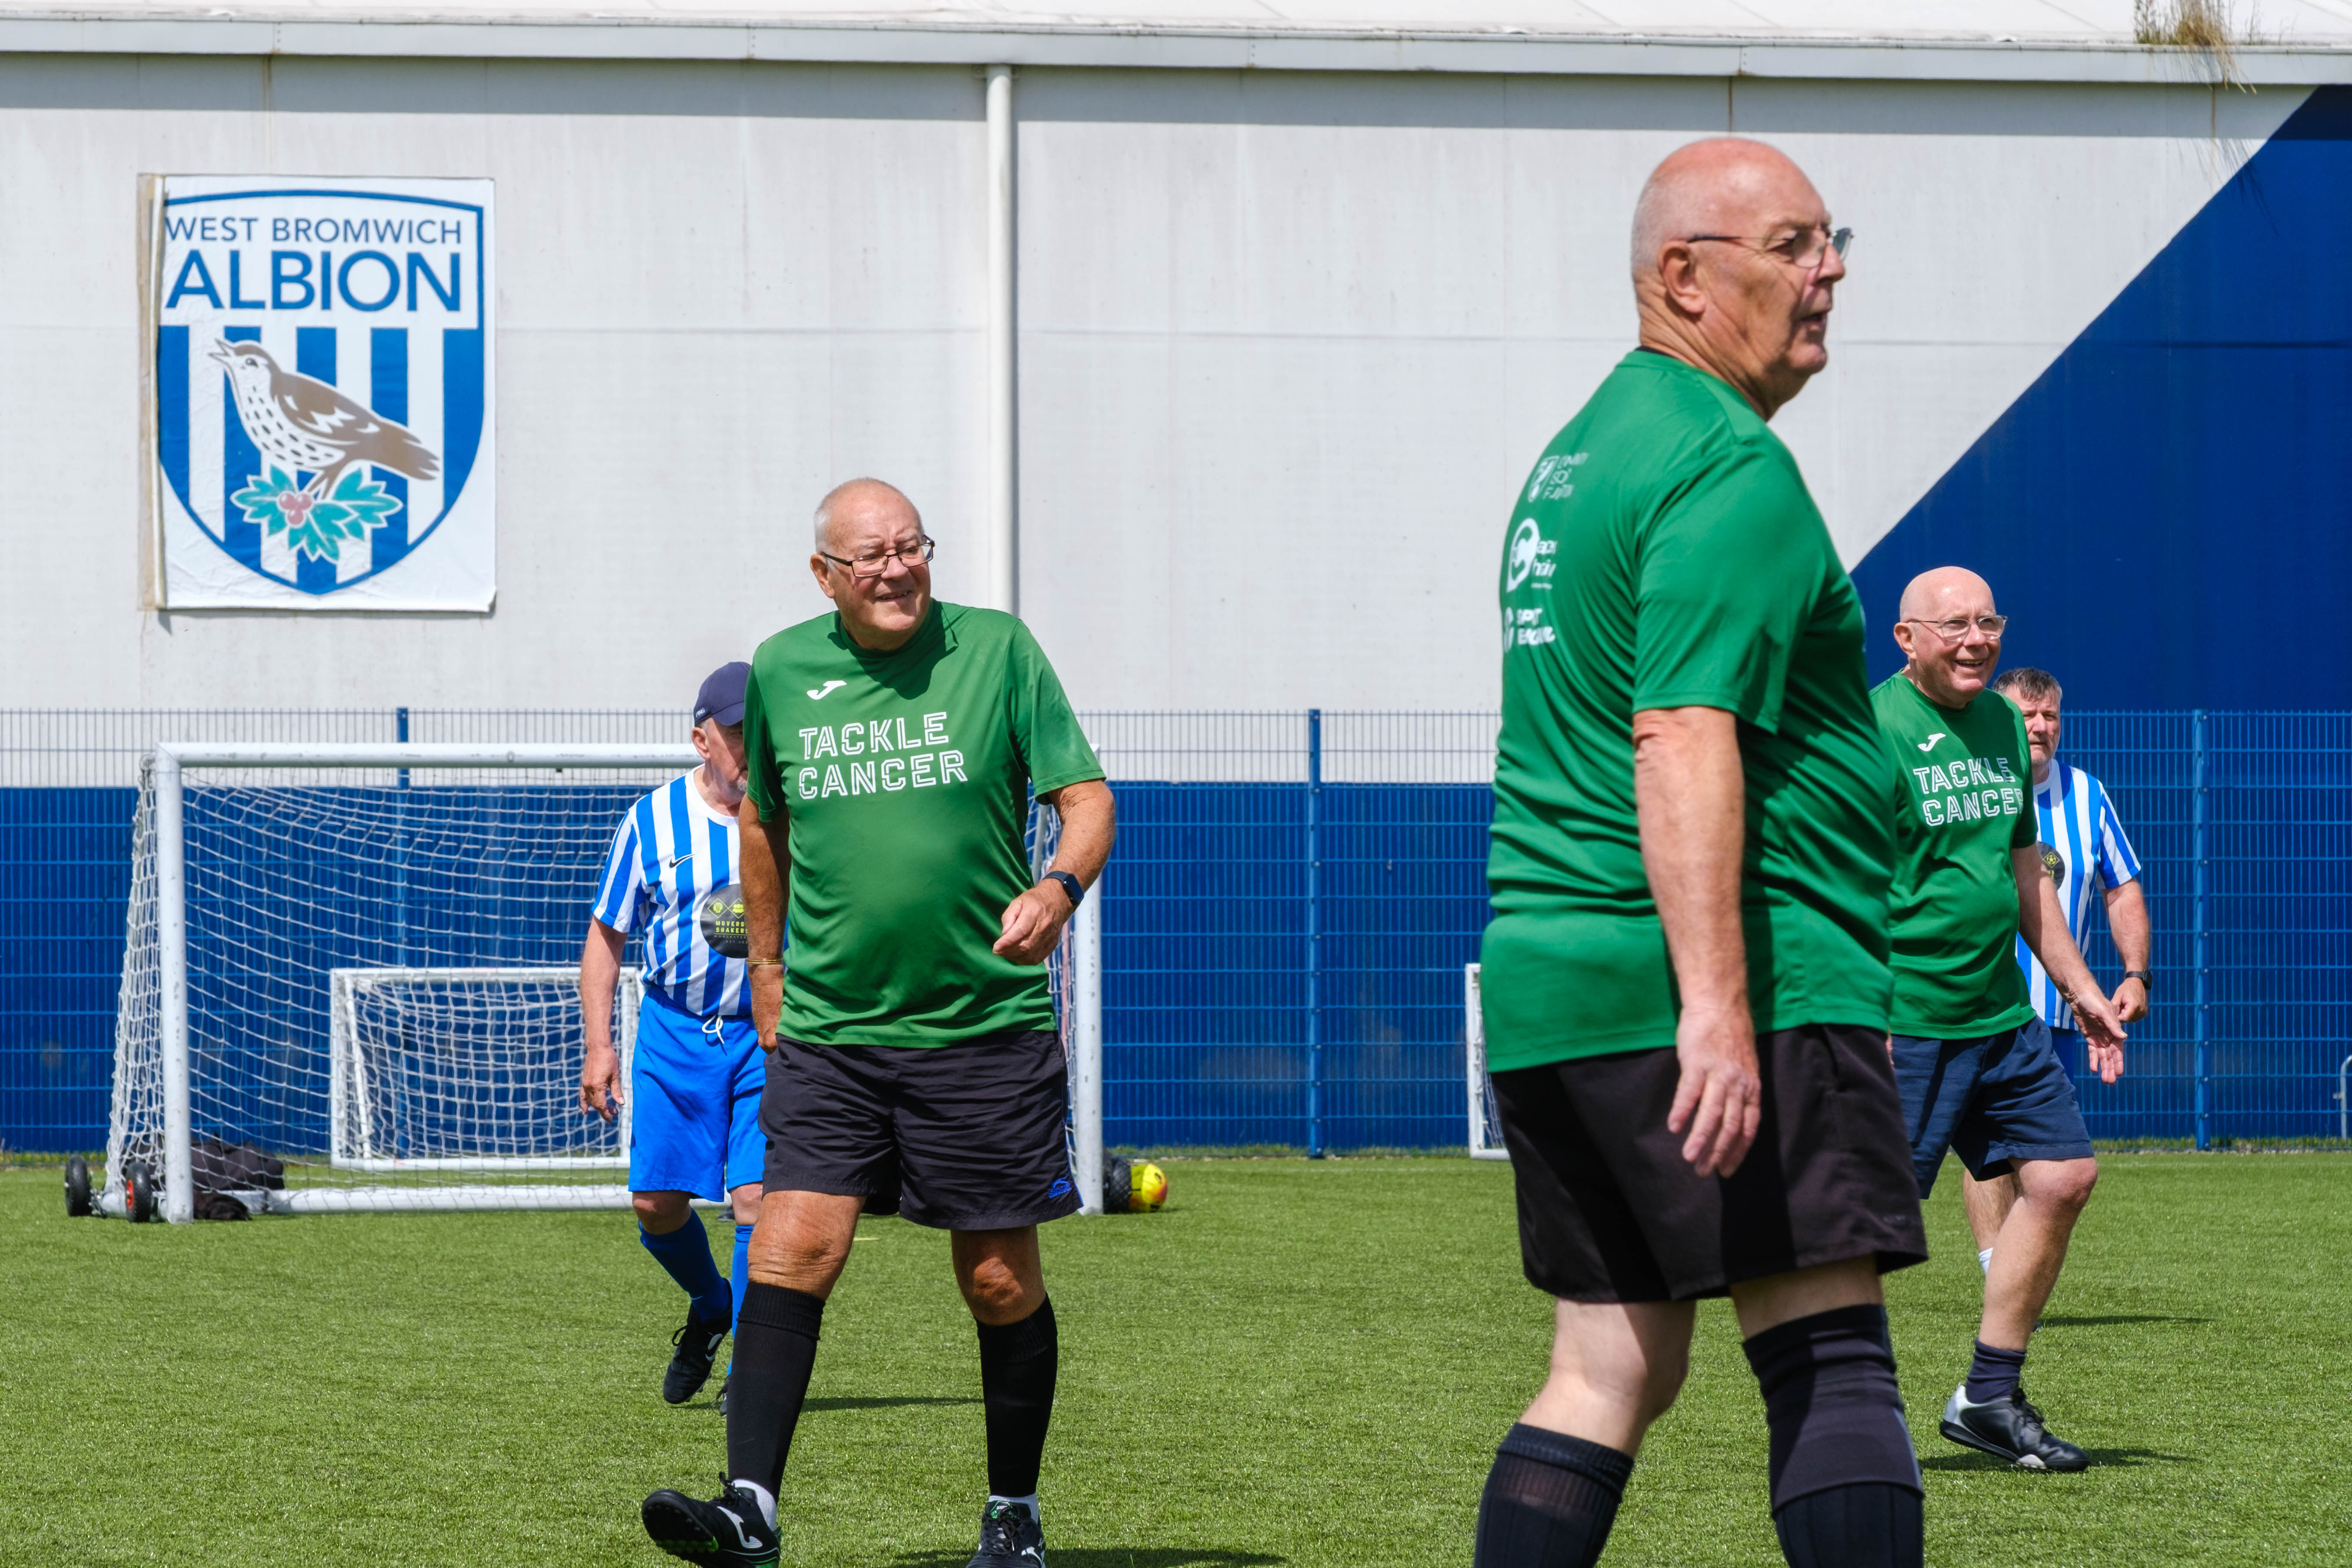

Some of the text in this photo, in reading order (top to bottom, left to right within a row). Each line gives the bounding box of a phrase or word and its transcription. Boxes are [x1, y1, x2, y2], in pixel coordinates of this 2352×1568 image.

[164, 217, 462, 244] WEST BROMWICH
[165, 249, 461, 312] ALBION
[798, 711, 949, 760] TACKLE
[799, 749, 968, 800] CANCER
[1913, 757, 2016, 795] TACKLE
